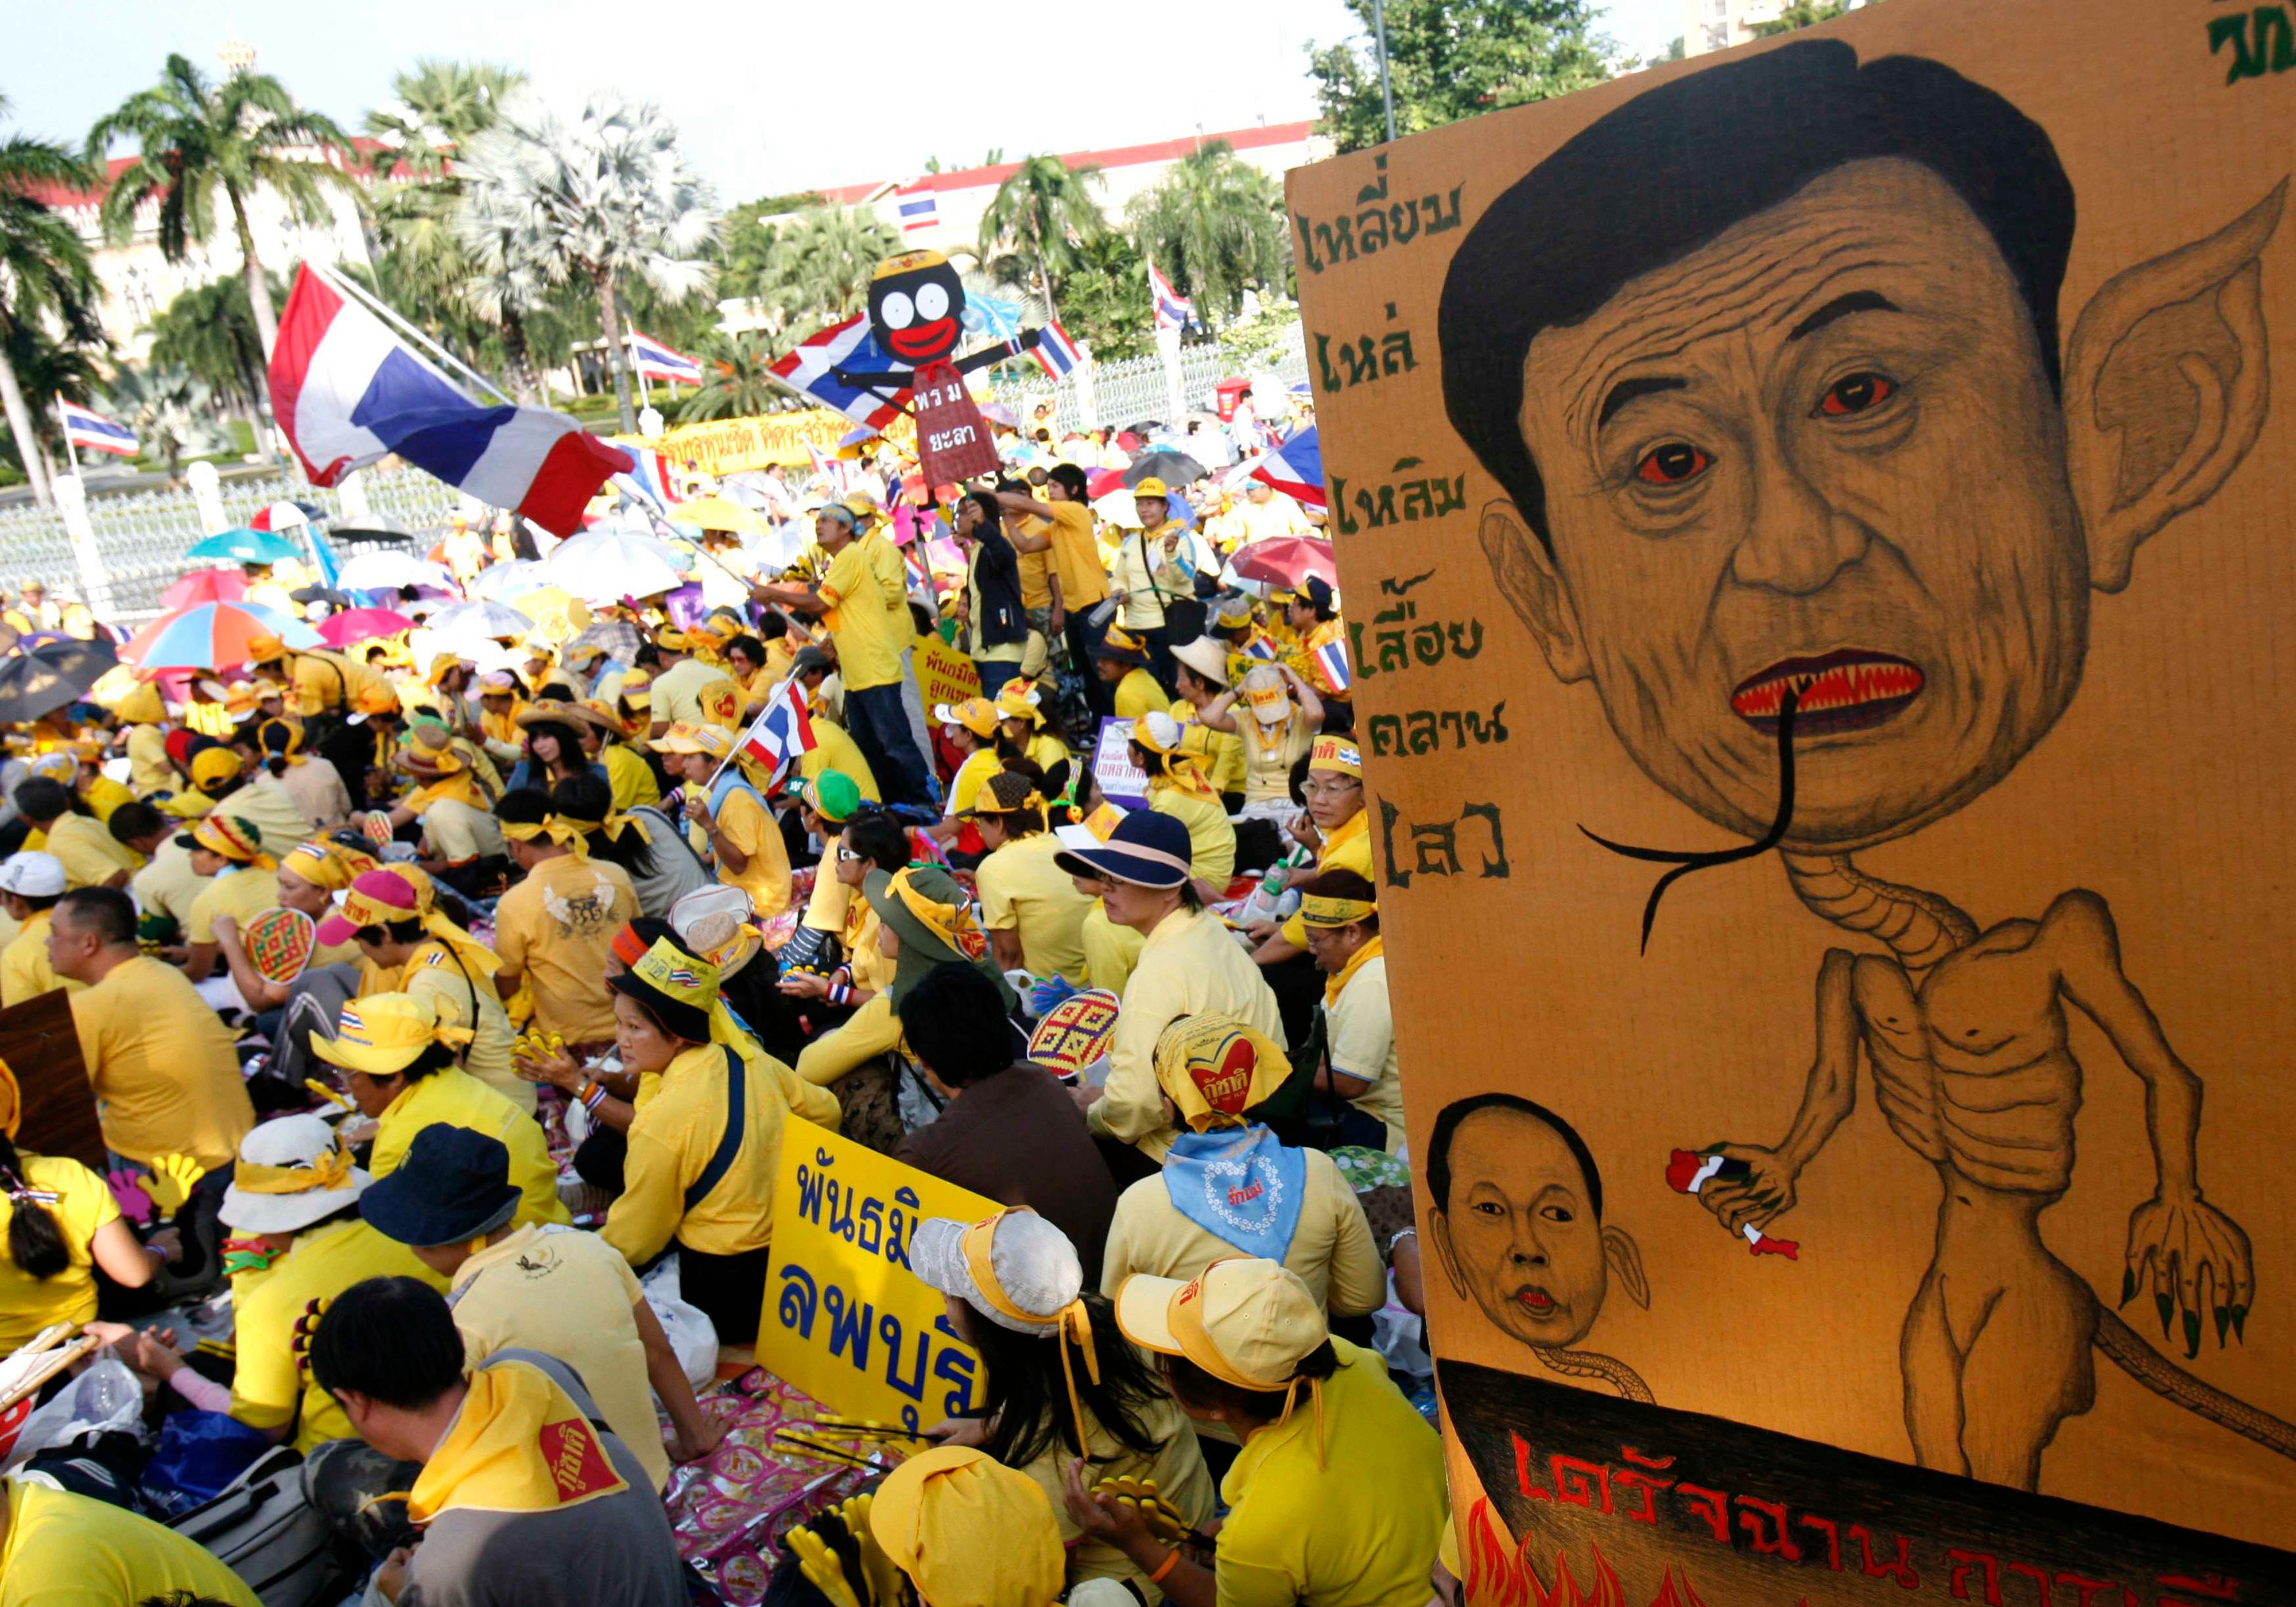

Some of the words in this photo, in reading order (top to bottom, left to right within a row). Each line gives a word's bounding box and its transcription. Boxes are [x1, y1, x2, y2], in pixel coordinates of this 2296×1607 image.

[914, 383, 962, 411] พรม
[929, 425, 976, 452] ยะลา
[1330, 457, 1466, 535] เหลิม
[1349, 568, 1484, 679] เลื้อย
[1368, 699, 1508, 758] คลาน
[1377, 794, 1510, 889] เลว
[1203, 1067, 1249, 1106] กู้ชาติ
[796, 1147, 920, 1271] พันธมิ
[552, 1423, 587, 1491] กู้ชาติ
